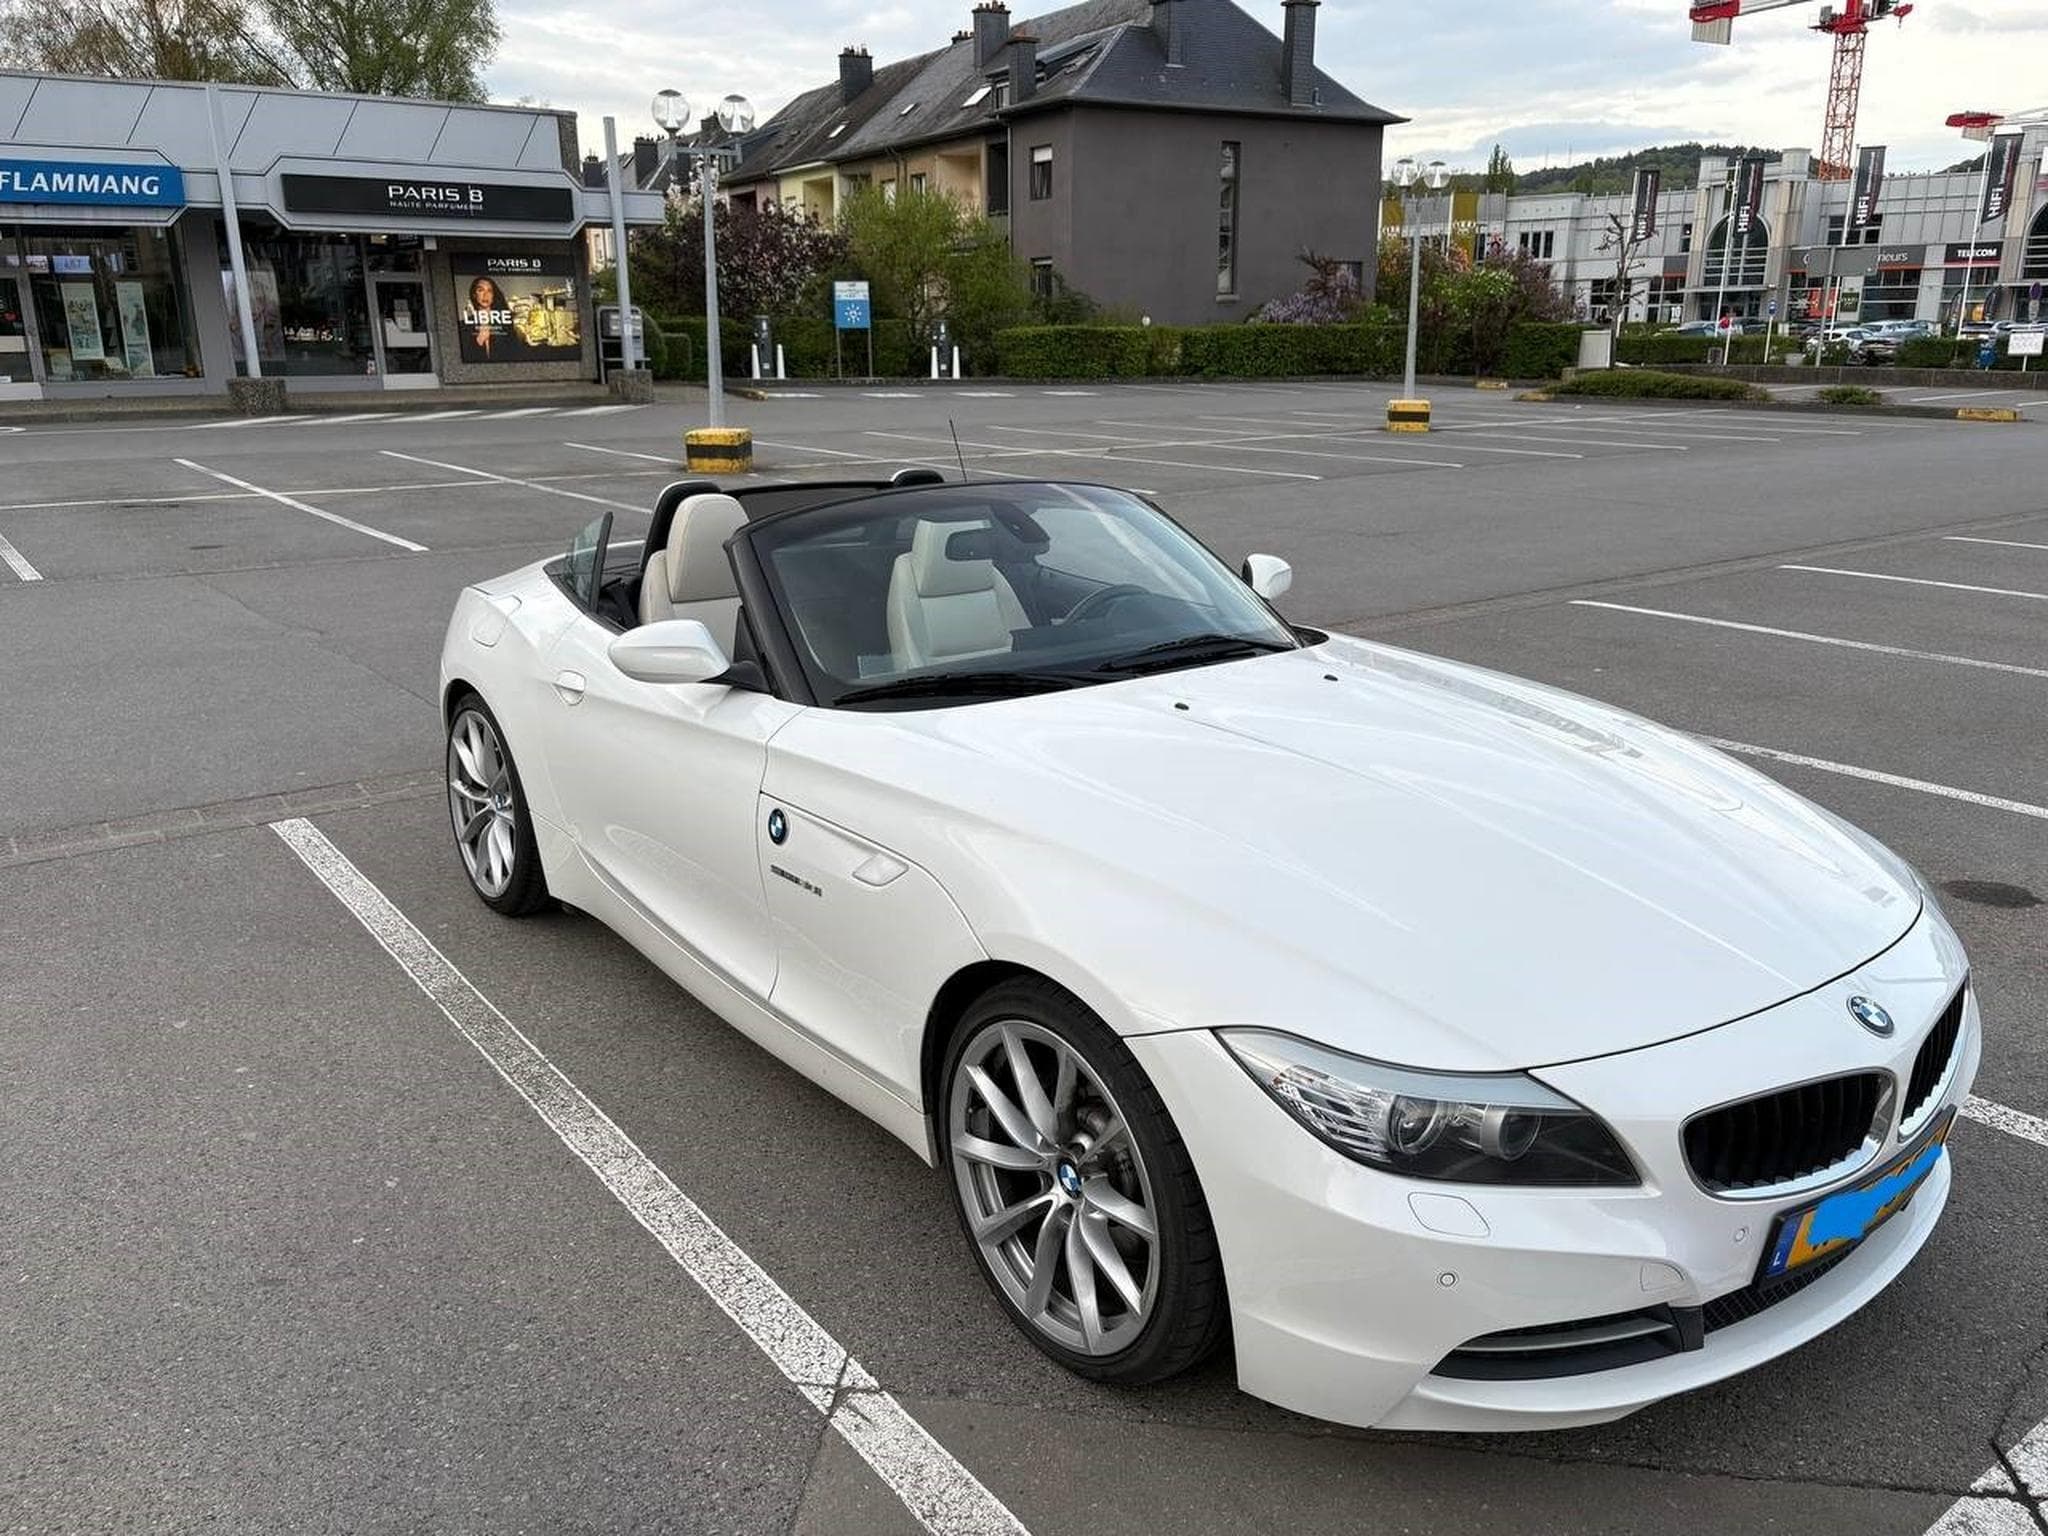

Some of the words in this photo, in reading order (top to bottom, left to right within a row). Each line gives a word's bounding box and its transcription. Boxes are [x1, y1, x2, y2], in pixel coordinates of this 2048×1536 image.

[0, 171, 160, 195] FLAMMANG
[388, 184, 460, 201] PARIS
[389, 201, 421, 209] HAUTE
[1855, 196, 1871, 225] HiFi
[1988, 187, 2004, 217] HiFi
[1738, 205, 1751, 233] HiFi
[487, 258, 529, 268] PARIS
[463, 309, 513, 325] LIBRE
